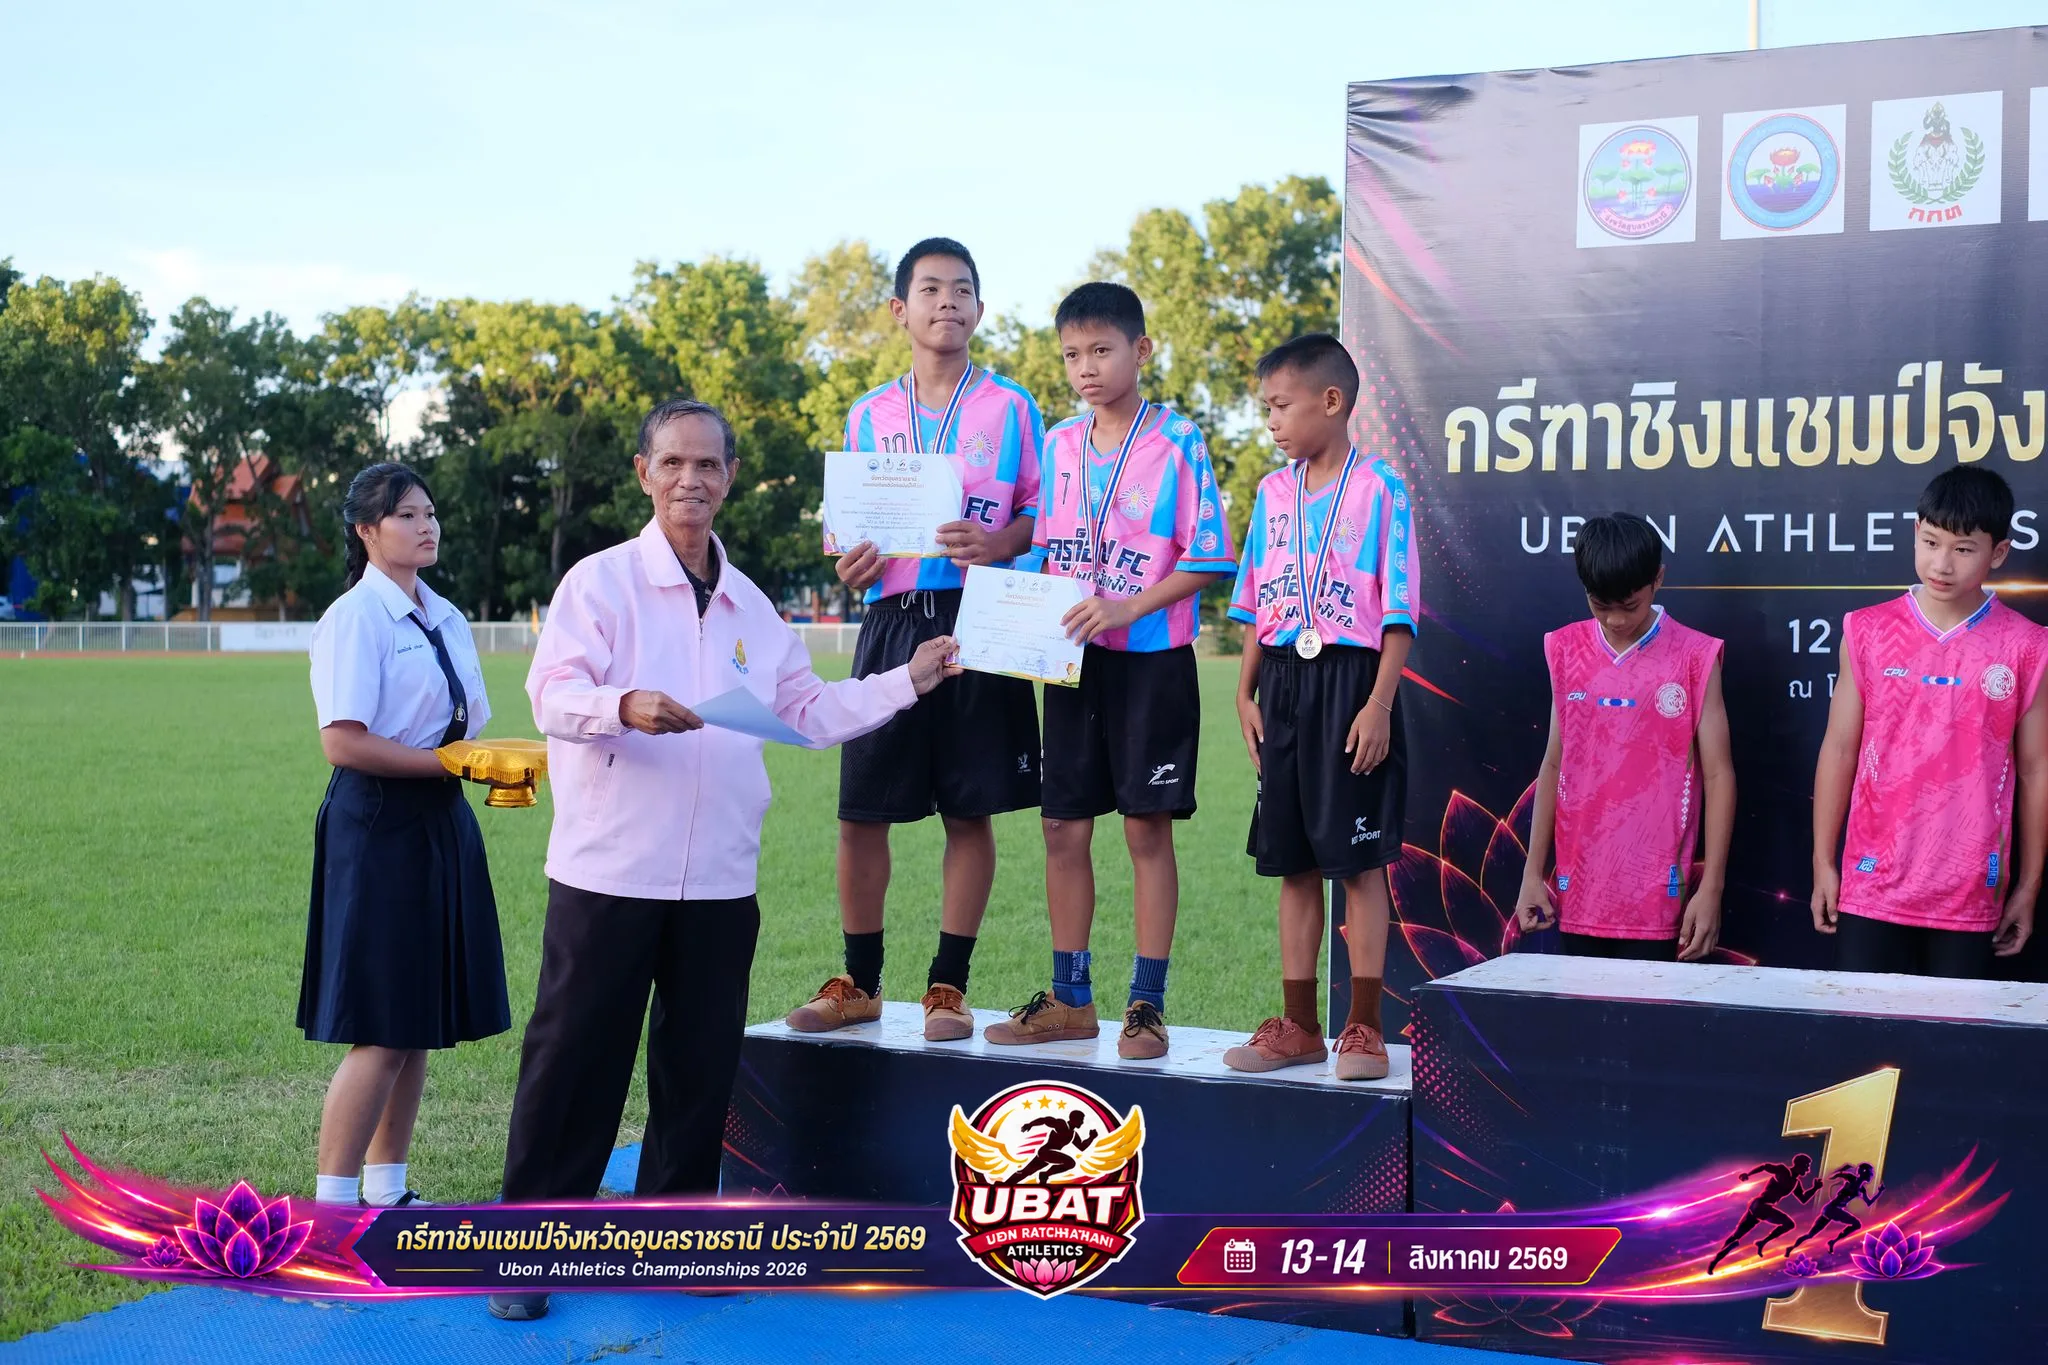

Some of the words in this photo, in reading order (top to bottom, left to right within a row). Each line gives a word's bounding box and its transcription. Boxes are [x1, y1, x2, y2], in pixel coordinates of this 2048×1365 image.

[1061, 472, 1071, 505] 7
[963, 496, 999, 524] FC
[1268, 514, 1290, 550] 32
[1521, 514, 1676, 553] UBN
[1706, 510, 2040, 553] ATHLES
[1115, 548, 1151, 577] FC
[1789, 680, 1812, 698] ณ
